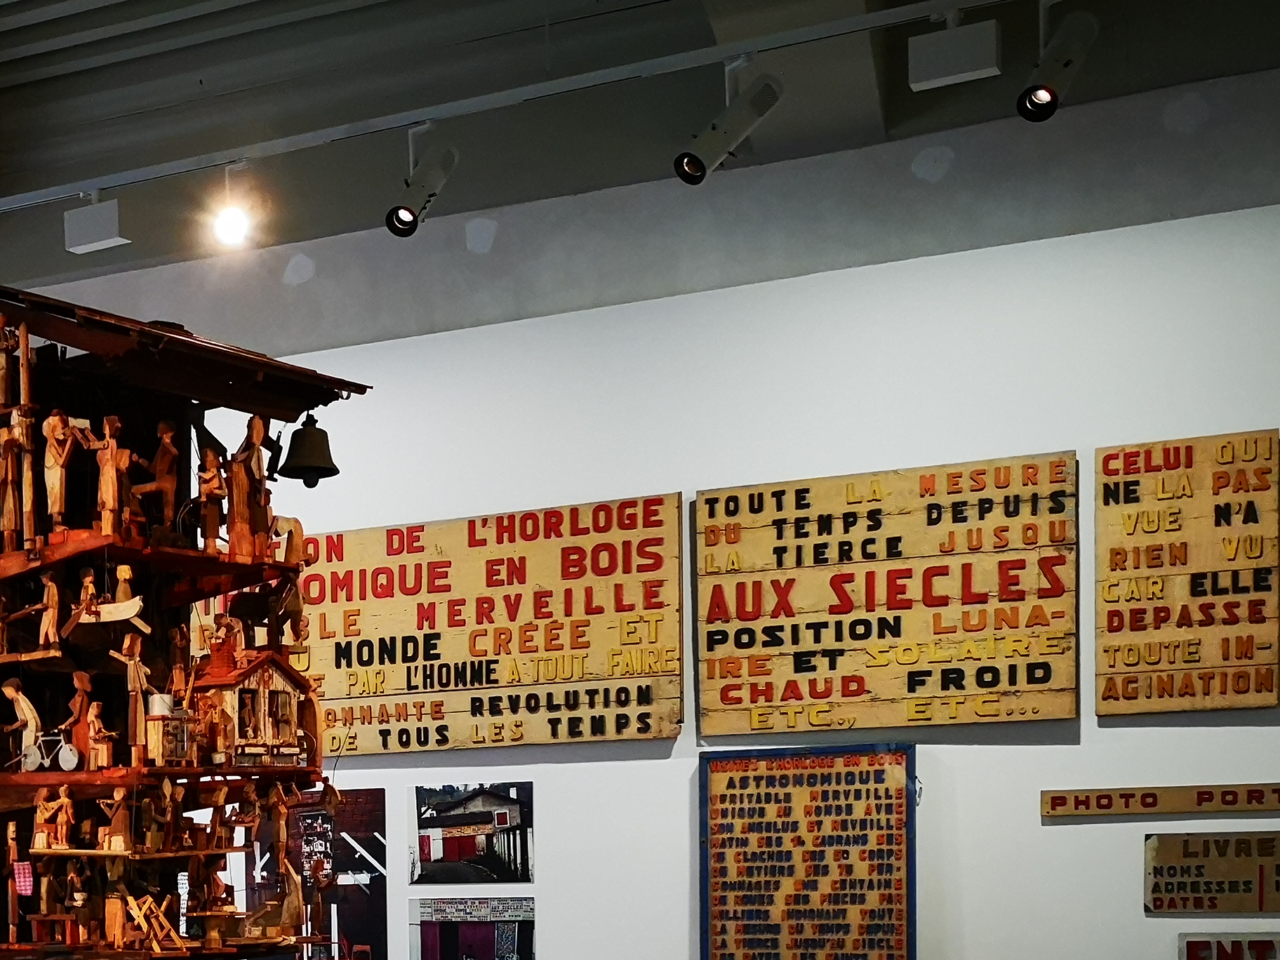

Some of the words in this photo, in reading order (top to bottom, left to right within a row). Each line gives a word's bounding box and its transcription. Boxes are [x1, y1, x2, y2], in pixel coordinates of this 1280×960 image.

[1102, 445, 1193, 476] CELUI
[1215, 437, 1272, 465] QUI
[705, 488, 811, 519] TOUTE
[846, 480, 882, 505] LA
[920, 460, 1066, 498] MESURE
[1103, 480, 1140, 506] NE
[1156, 475, 1193, 501] LA
[1212, 468, 1272, 495] PAS
[303, 534, 343, 565] ON
[386, 526, 424, 556] DE
[467, 497, 664, 548] L'HORLOGE
[705, 523, 741, 547] DU
[772, 509, 882, 540] TEMPS
[926, 490, 1066, 526] DEPUIS
[1122, 507, 1181, 535] VUE
[1214, 501, 1259, 527] N'A
[705, 550, 741, 574] LA
[773, 536, 902, 568] TIERCE
[939, 520, 1066, 553] JUSQU
[1110, 542, 1188, 571] RIEN
[1222, 535, 1263, 560] VU
[303, 560, 452, 605] OMIQUE
[485, 556, 526, 587] EN
[561, 537, 663, 580] BOIS
[706, 578, 795, 624] AUX
[828, 555, 1066, 616] SIECLES
[1102, 576, 1164, 602] CAR
[1190, 568, 1272, 597] ELLE
[416, 580, 665, 631] MERVEILLE
[1107, 599, 1266, 633] DEPASSE
[334, 633, 441, 669] MONDE
[620, 614, 664, 645] ET
[706, 616, 901, 652] POSITION
[933, 605, 1065, 635] LUNA-
[706, 654, 772, 680] IRE
[793, 649, 845, 673] ET
[866, 635, 1065, 668] SOLAIRE
[1104, 638, 1201, 668] TOUTE
[1222, 635, 1272, 660] IM-
[346, 669, 384, 696] PAR
[406, 659, 499, 691] L'HOMME
[531, 653, 588, 682] TOUT
[606, 647, 676, 677] FAIRE
[720, 675, 866, 705] CHAUD
[907, 662, 1051, 694] FROID
[1102, 668, 1273, 701] AGINATION
[324, 701, 444, 727] ONNANTE
[470, 684, 653, 718] REVOLUTION
[329, 732, 358, 752] DE
[379, 724, 449, 750] TOUS
[472, 720, 523, 744] LES
[548, 712, 651, 739] TEMPS
[844, 754, 860, 767] EN
[726, 770, 885, 790] ASTRONOMIQUE
[810, 787, 903, 804] MERVEILLE
[1051, 793, 1158, 811] PHOTO
[1183, 837, 1276, 859] LIVRE
[1152, 881, 1252, 894] ADRESSES
[1153, 865, 1205, 878] NOMS
[1153, 897, 1217, 910] DATES
